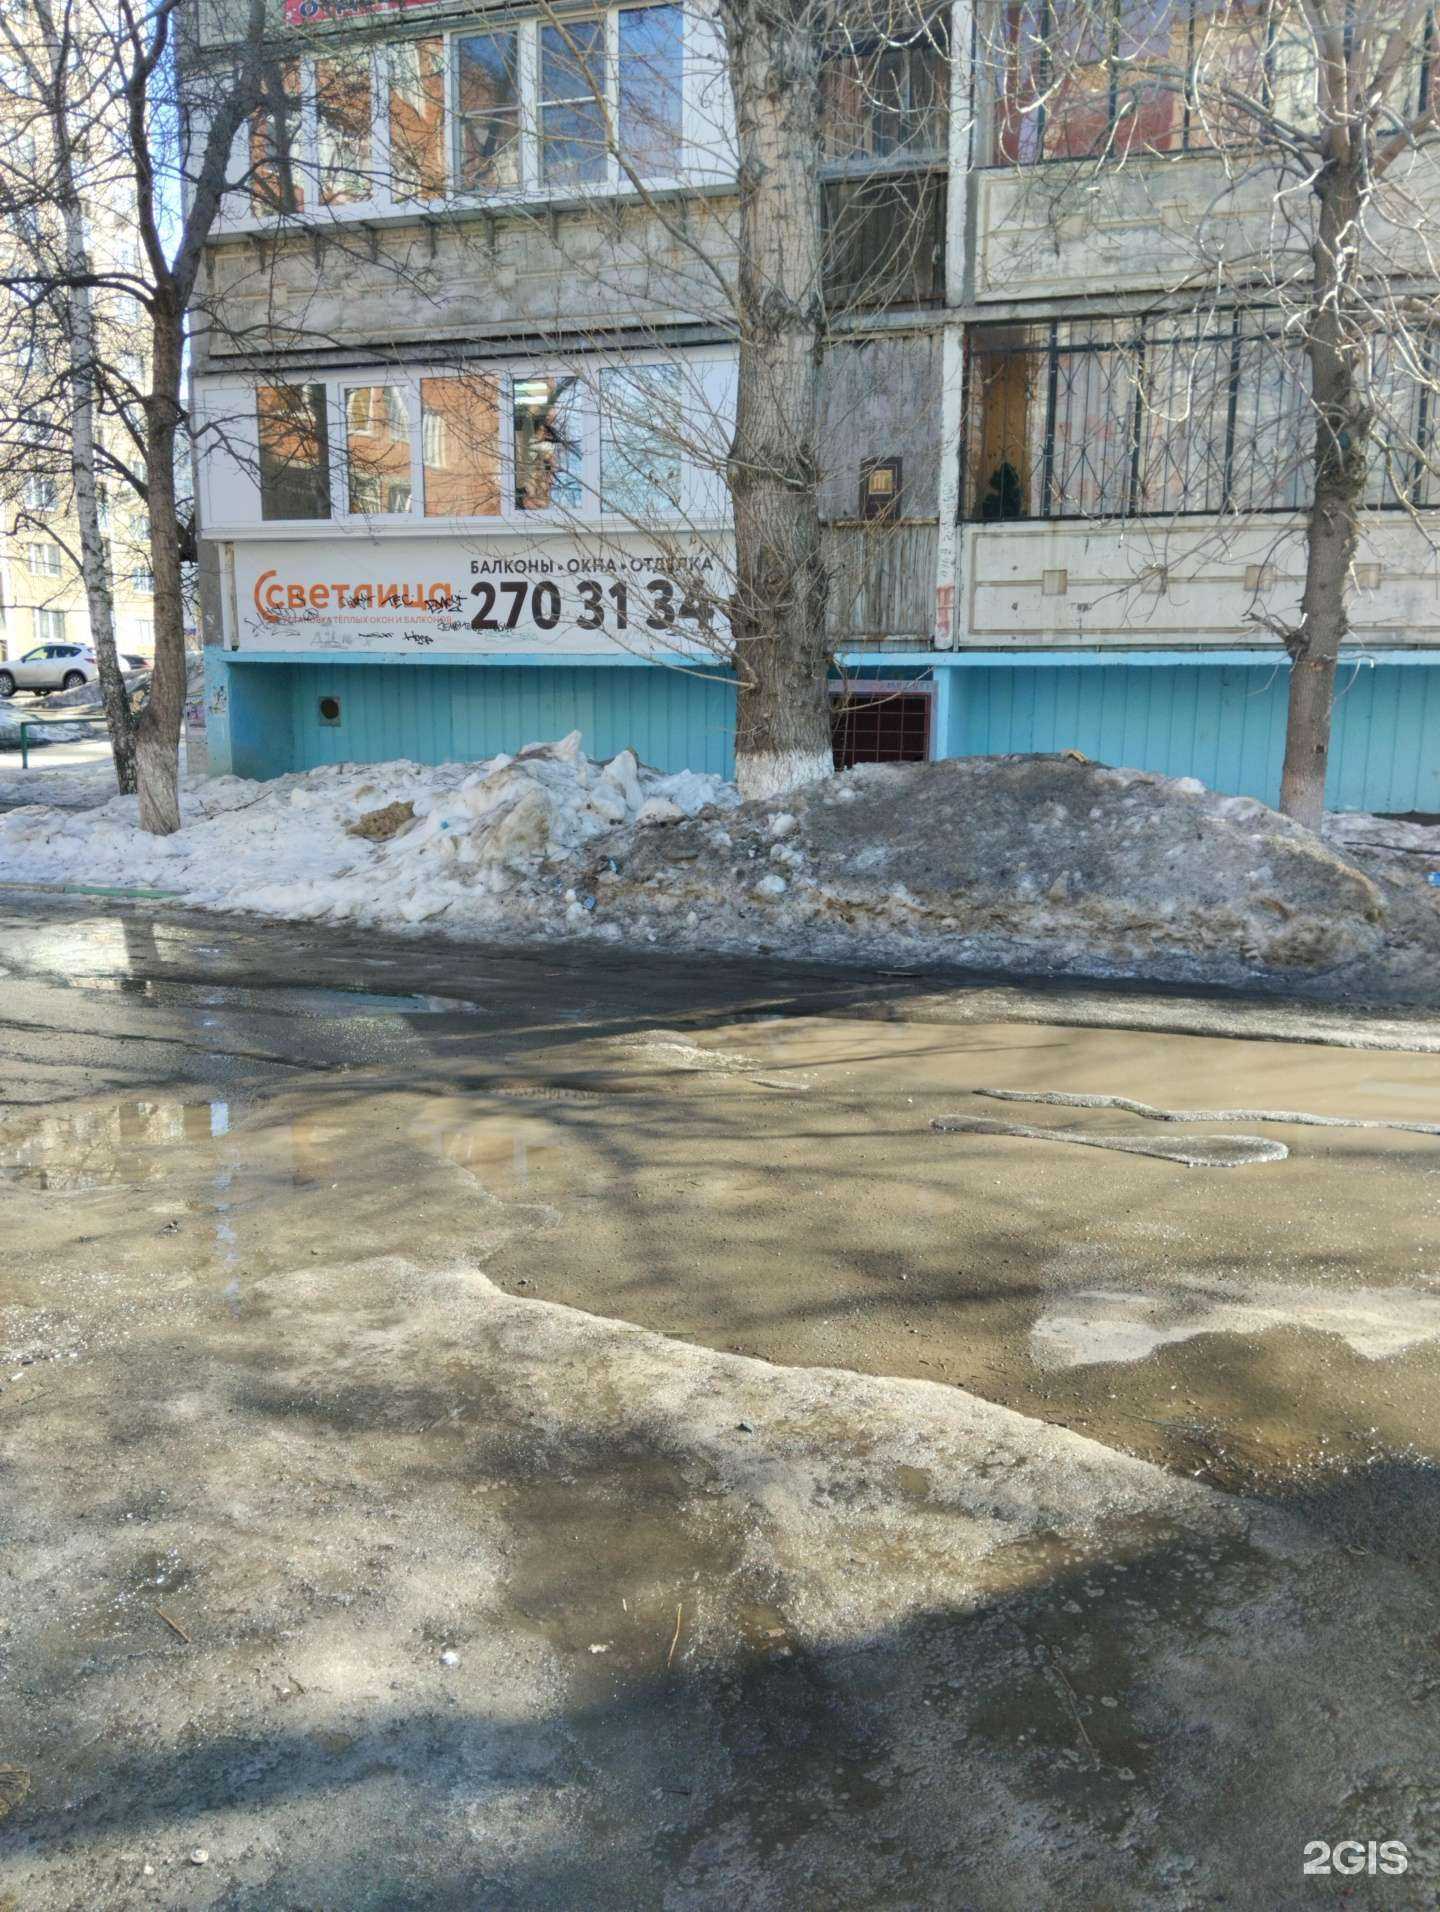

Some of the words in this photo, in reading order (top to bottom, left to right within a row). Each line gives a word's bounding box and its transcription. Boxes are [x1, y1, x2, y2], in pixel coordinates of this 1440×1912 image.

[470, 559, 554, 574] БАЛКОНЫ
[567, 558, 617, 573] ОКНА
[470, 580, 562, 630] 270
[576, 580, 628, 630] 31
